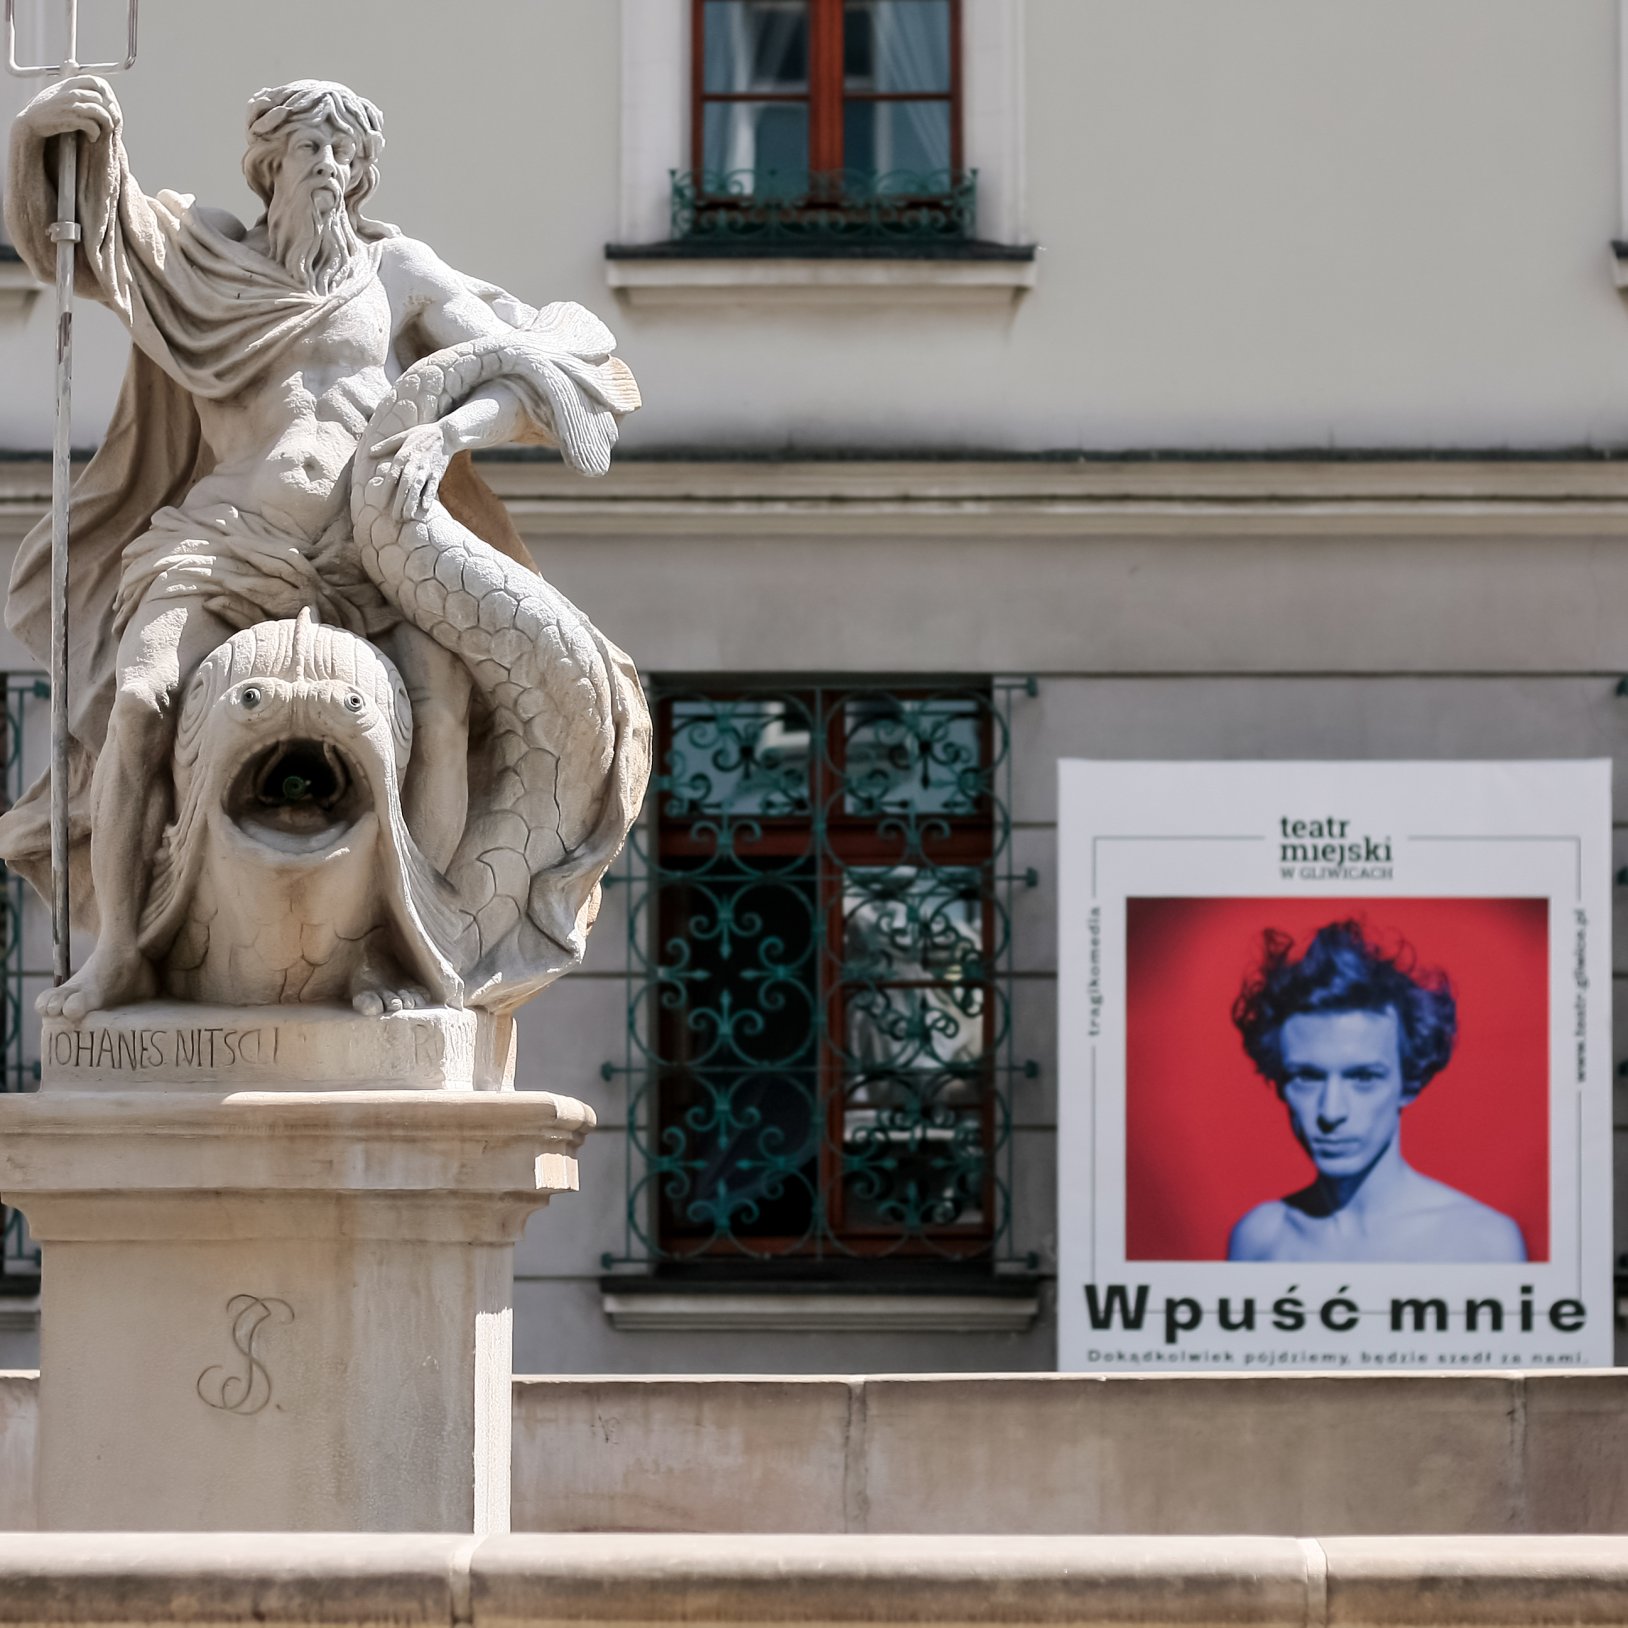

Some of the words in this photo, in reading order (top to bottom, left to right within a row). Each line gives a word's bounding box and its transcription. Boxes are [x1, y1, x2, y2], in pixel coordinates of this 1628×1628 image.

[1280, 816, 1350, 839] teatr
[1280, 835, 1392, 867] miejski
[1280, 867, 1295, 879] W
[1299, 866, 1394, 880] GLIWICACH
[1087, 906, 1103, 1036] tragikomedia
[1083, 1283, 1360, 1345] Wpuść
[1390, 1284, 1587, 1333] mnie
[1087, 1350, 1235, 1365] Dokądkolwiek
[1360, 1351, 1429, 1366] będzie
[1438, 1351, 1493, 1365] szedł
[1501, 1353, 1523, 1365] za
